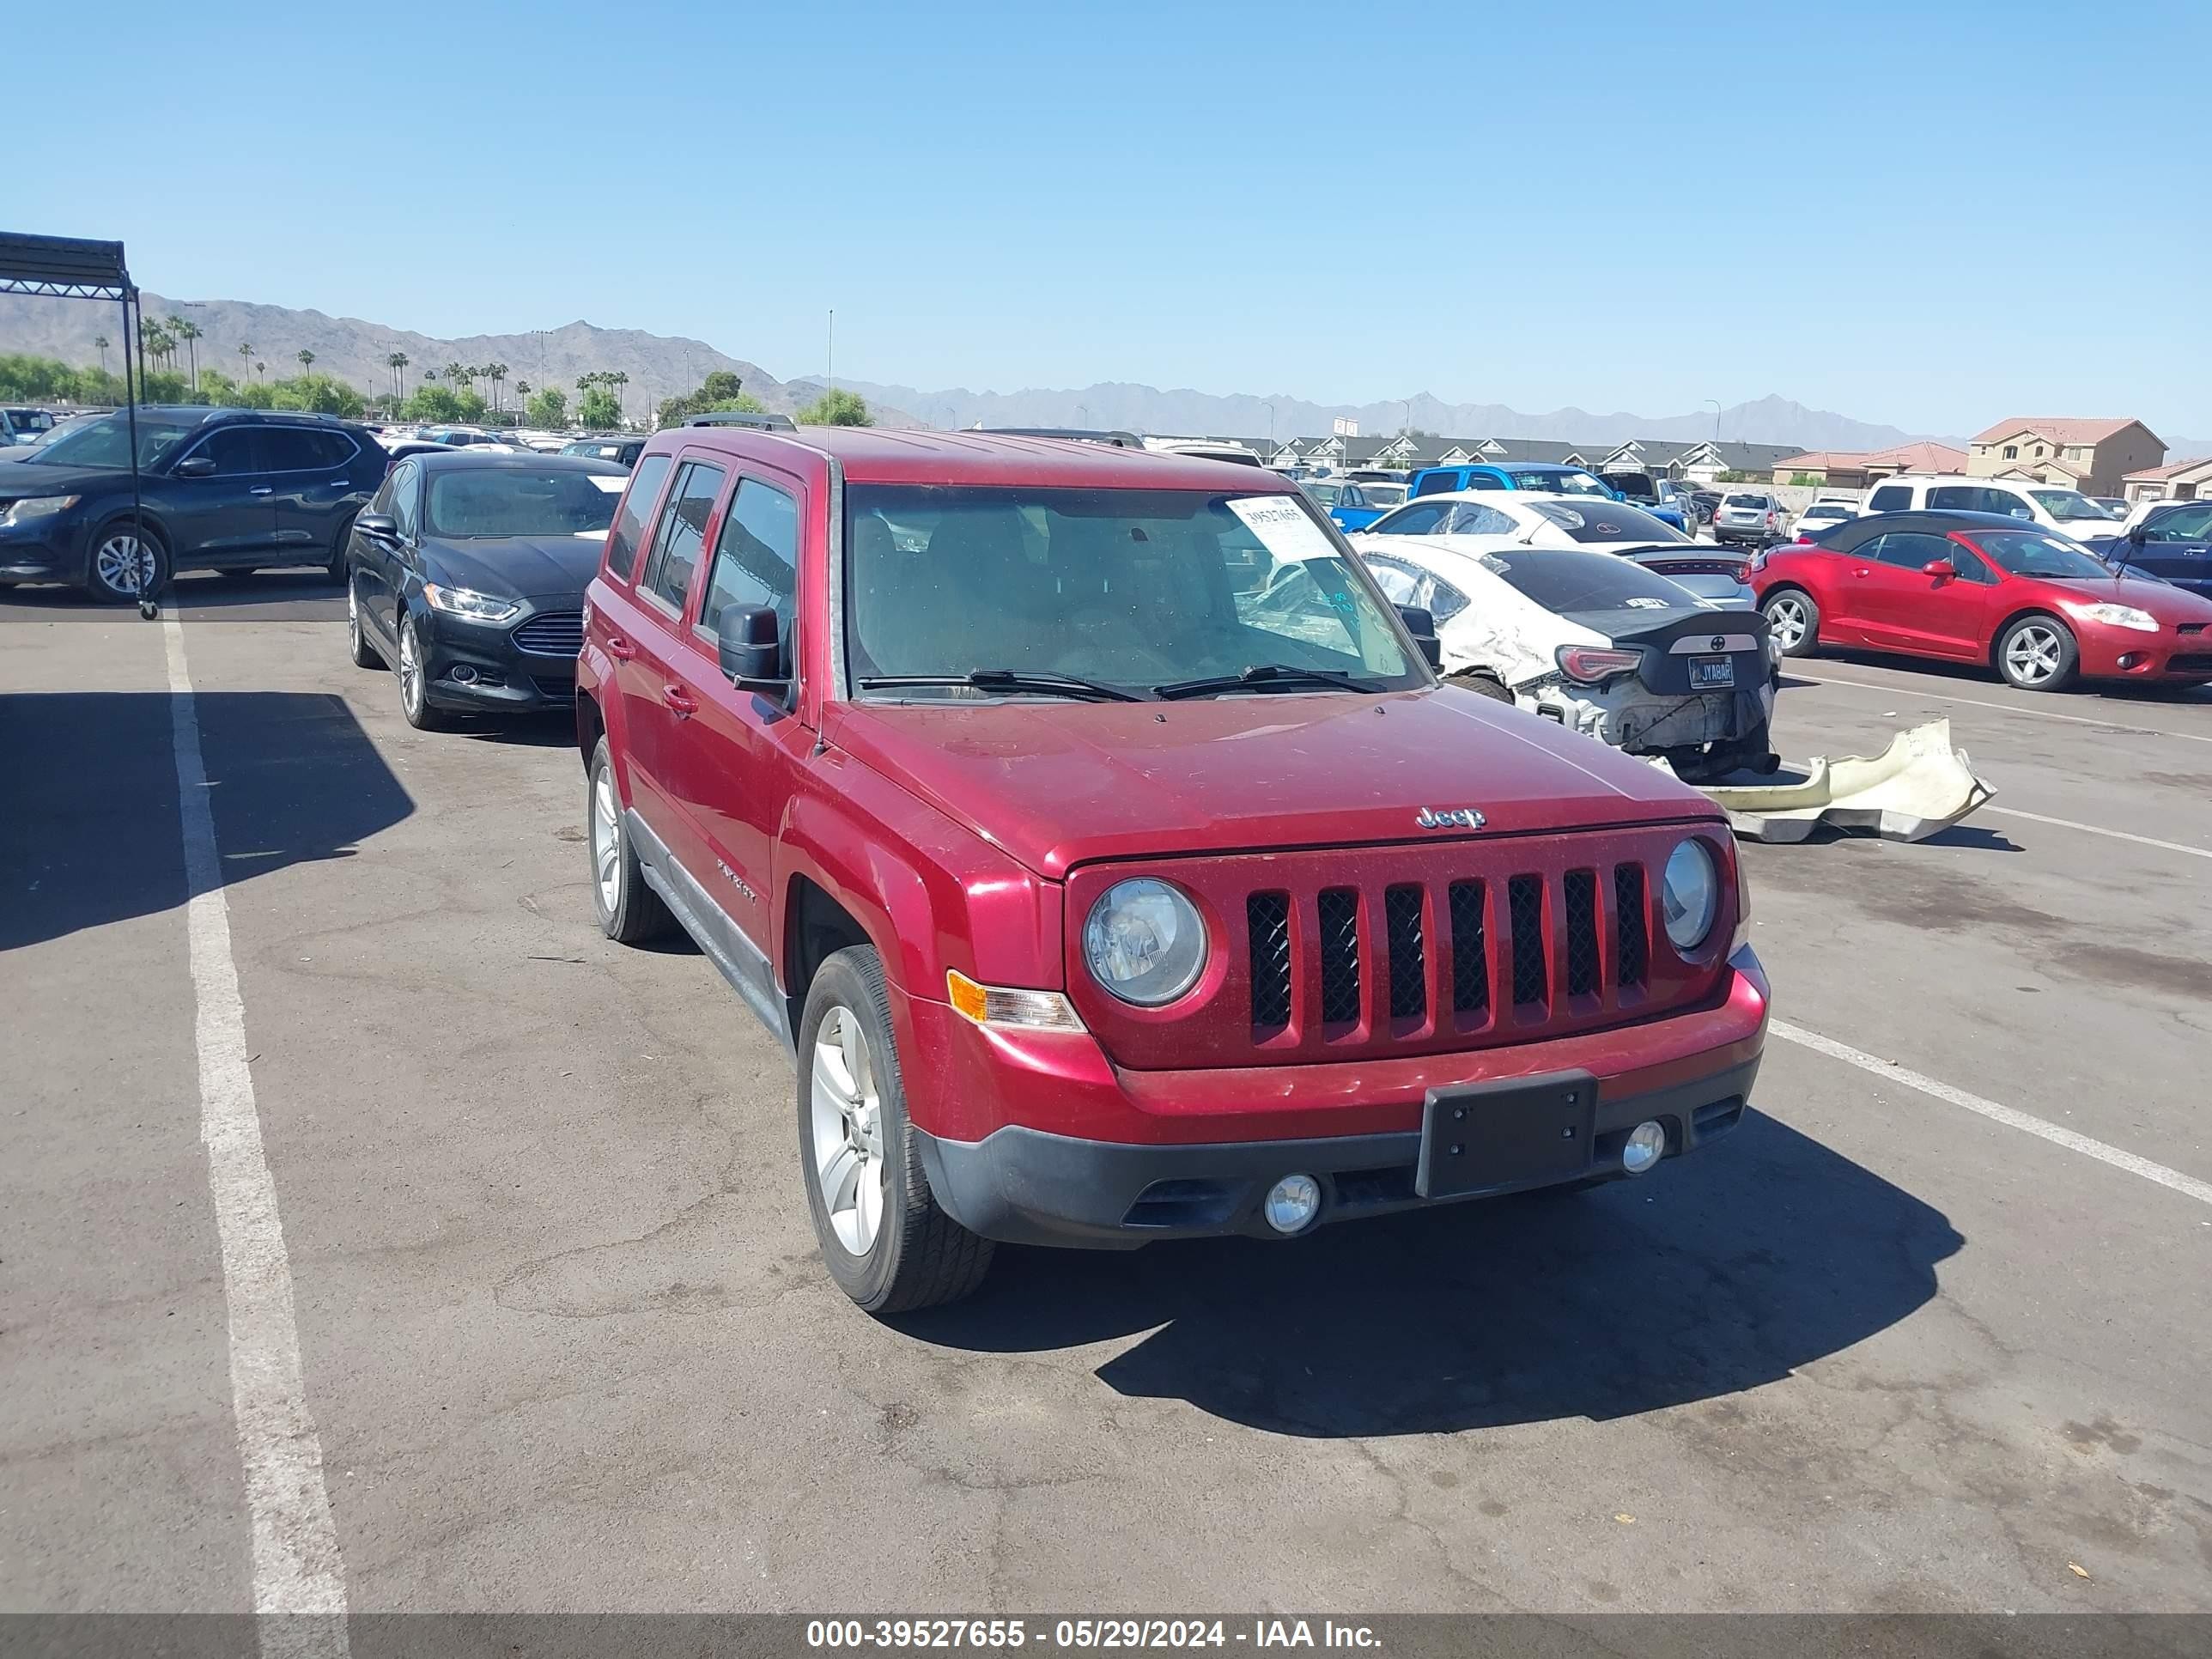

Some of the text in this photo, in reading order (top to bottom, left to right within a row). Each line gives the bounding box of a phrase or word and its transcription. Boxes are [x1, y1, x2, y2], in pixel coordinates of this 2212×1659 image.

[1246, 508, 1303, 525] 39527655
[1702, 663, 1732, 682] JYA8AR
[1415, 806, 1486, 830] Jeep
